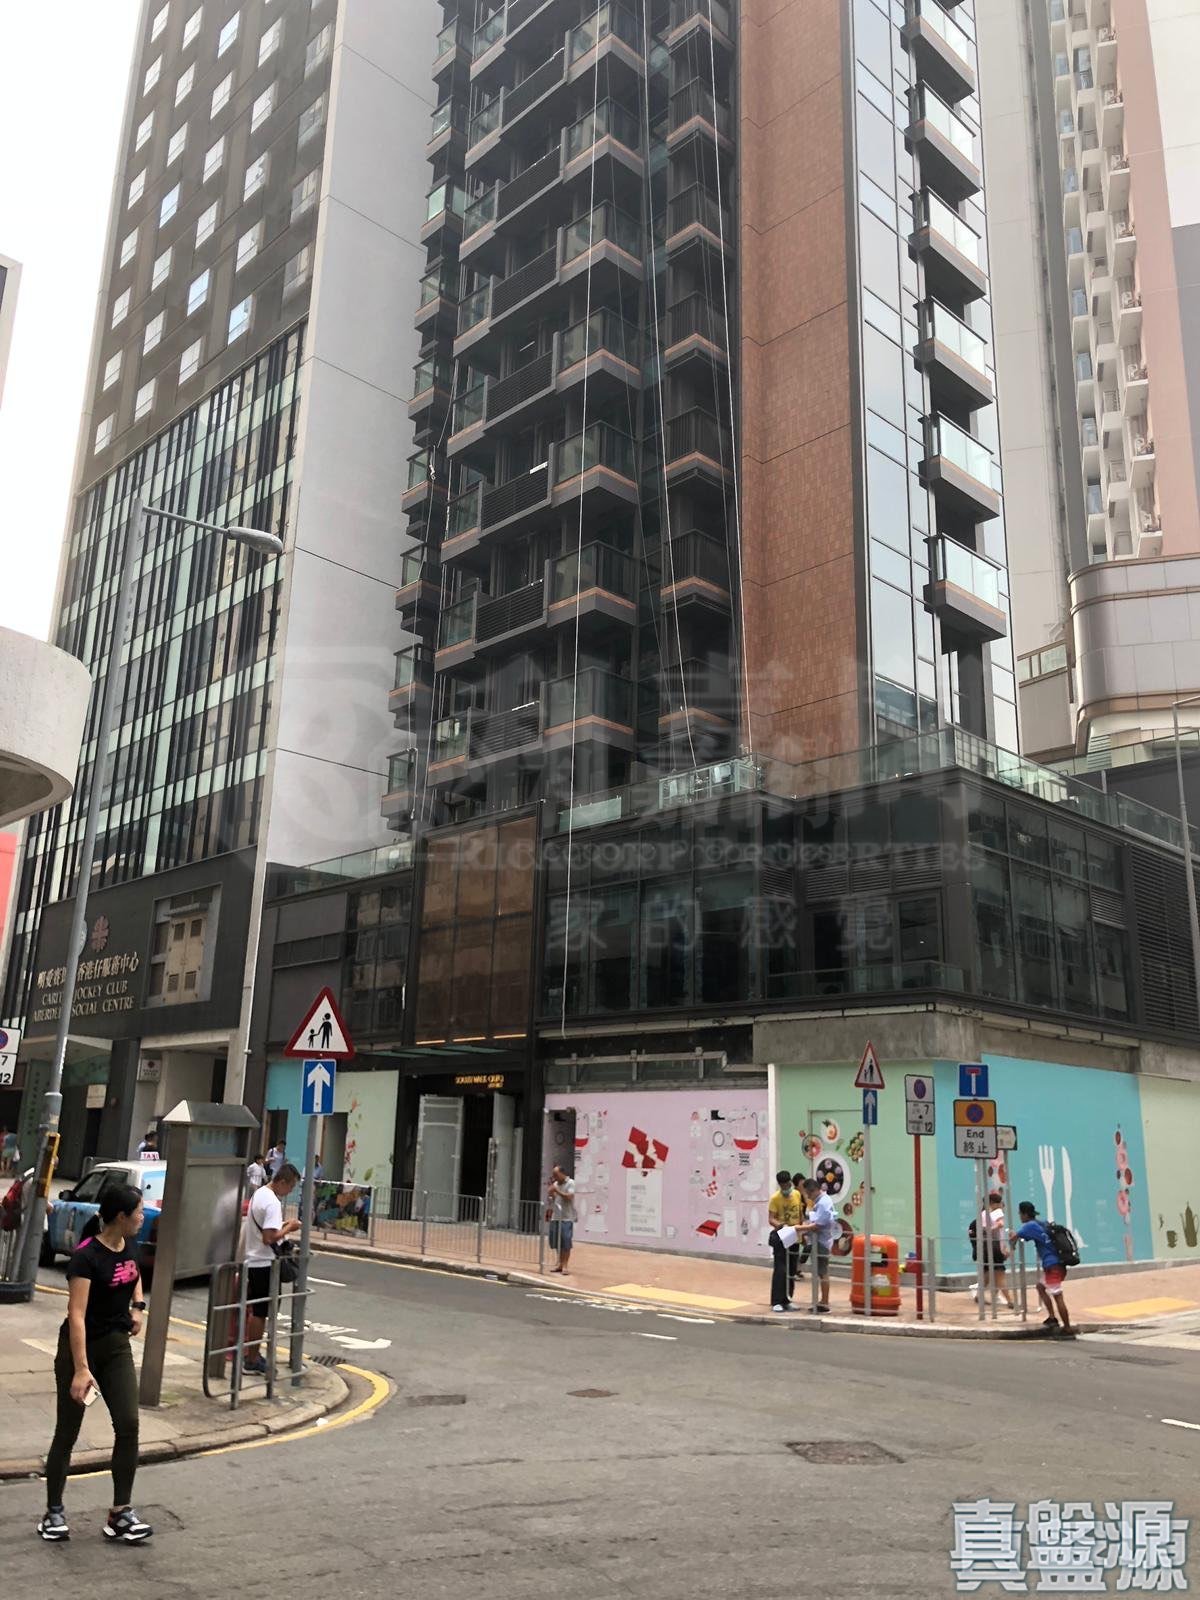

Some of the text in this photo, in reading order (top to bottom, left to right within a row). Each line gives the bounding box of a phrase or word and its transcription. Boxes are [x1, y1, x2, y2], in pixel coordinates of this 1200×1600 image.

[106, 980, 128, 995] CLUB
[71, 1001, 98, 1017] SOCIAL
[102, 996, 134, 1013] CENTRE
[2, 1055, 8, 1066] 7
[924, 1104, 930, 1115] 7
[925, 1121, 933, 1132] 12
[966, 1129, 984, 1138] End
[963, 1141, 988, 1154] 終止
